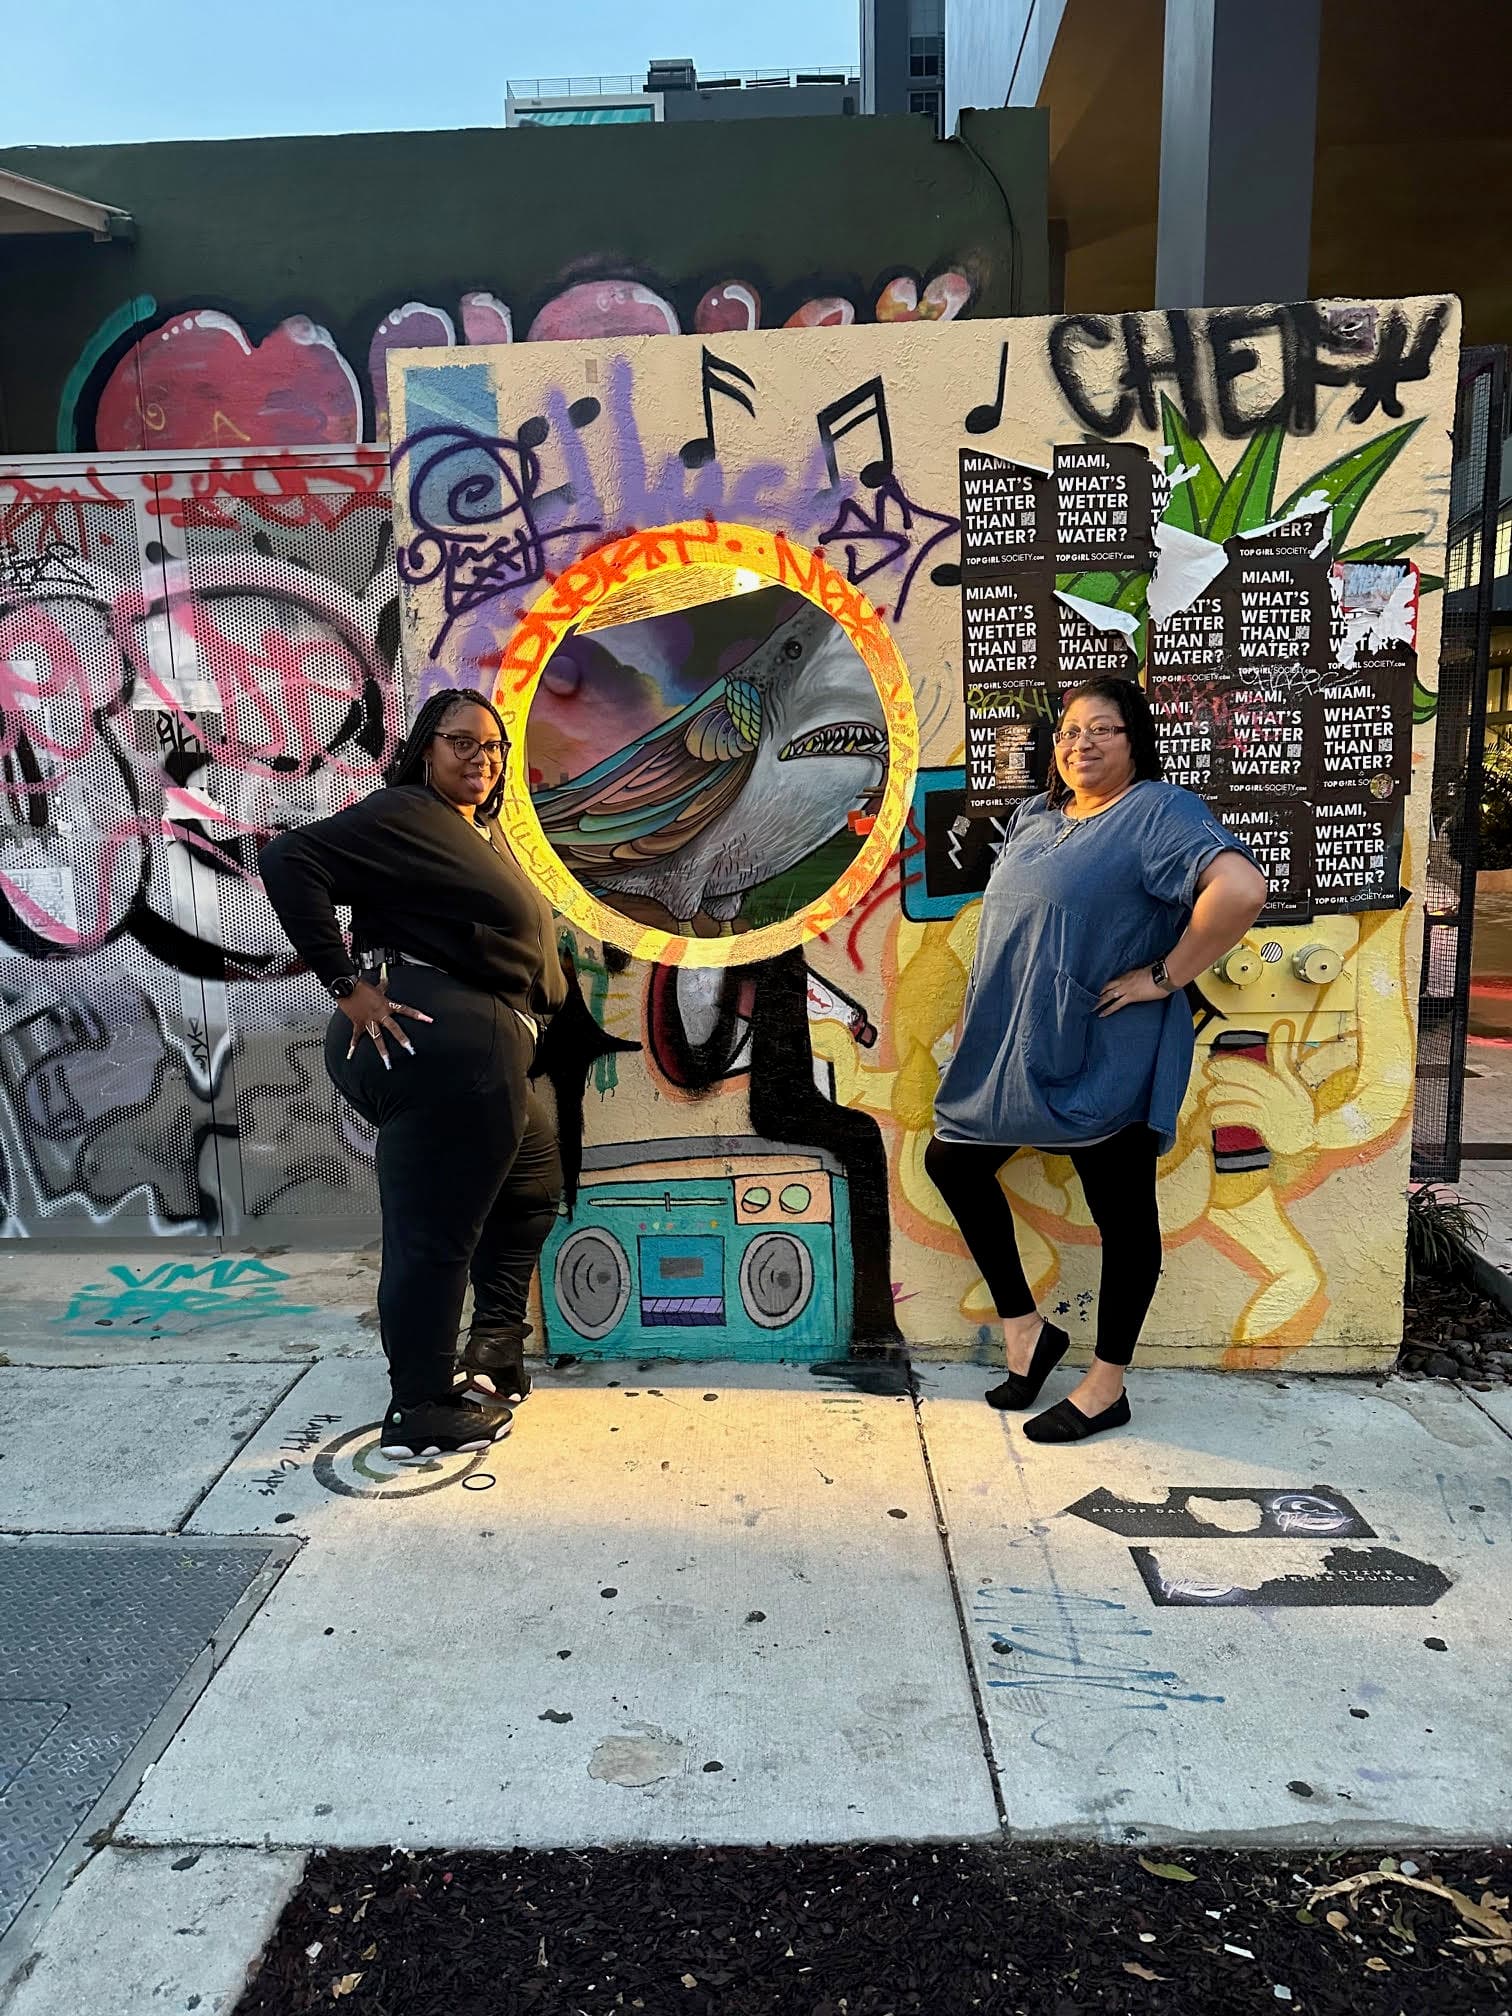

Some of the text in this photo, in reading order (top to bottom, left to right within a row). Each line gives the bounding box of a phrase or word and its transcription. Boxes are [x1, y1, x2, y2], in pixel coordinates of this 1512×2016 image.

[1057, 454, 1111, 469] MIAMI,
[964, 476, 1033, 495] WHAT'S
[1057, 475, 1126, 492] WHAT'S
[966, 494, 1036, 513] WETTER
[1058, 493, 1129, 509] WETTER
[966, 512, 1015, 530] THAN
[1057, 511, 1107, 526] THAN
[966, 529, 1037, 547] WATER?
[1057, 527, 1128, 544] WATER?
[1055, 554, 1071, 562] TOP
[1072, 553, 1090, 562] GIRL
[1255, 548, 1274, 556] GIRL
[966, 557, 982, 565] TOP
[982, 555, 1000, 564] GIRL
[1242, 570, 1294, 585] MIAMI,
[967, 585, 1018, 600] MIAMI,
[1241, 591, 1310, 607] WHAT'S
[967, 605, 1034, 623] WHAT'S
[1241, 608, 1311, 624] WETTER
[968, 623, 1037, 640] WETTER
[1155, 616, 1224, 632] WETTER
[1153, 633, 1203, 649] THAN
[1240, 626, 1289, 641] THAN
[968, 640, 1016, 656] THAN
[1059, 639, 1107, 653] THAN
[1240, 642, 1310, 657] WATER?
[968, 655, 1038, 673] WATER?
[1059, 654, 1128, 671] WATER?
[1153, 650, 1224, 665] WATER?
[1152, 675, 1167, 683] TOP
[1167, 674, 1186, 682] GIRL
[1238, 667, 1253, 675] TOP
[983, 682, 1001, 690] GIRL
[1057, 680, 1072, 688] TOP
[1235, 690, 1287, 704] MIAMI,
[1324, 685, 1376, 700] MIAMI,
[969, 706, 1020, 720] MIAMI,
[1234, 710, 1302, 725] WHAT'S
[1324, 705, 1392, 722] WHAT'S
[1155, 721, 1209, 737] HAT'S
[1234, 727, 1303, 742] WETTER
[1324, 722, 1393, 739] WETTER
[1155, 738, 1212, 754] ETTER
[1233, 744, 1282, 758] THAN
[1324, 739, 1373, 755] THAN
[1231, 760, 1301, 775] WATER?
[1324, 754, 1393, 772] WATER?
[1229, 784, 1243, 792] TOP
[1323, 780, 1338, 788] TOP
[1338, 779, 1357, 787] GIRL
[986, 798, 1003, 806] GIRL
[1316, 803, 1367, 818] MIAMI,
[1222, 811, 1274, 826] MIAMI,
[1236, 831, 1289, 846] HAT'S
[1315, 822, 1382, 840] WHAT'S
[1252, 847, 1291, 862] TTER
[1315, 839, 1385, 856] WETTER
[1315, 856, 1364, 872] THAN
[1315, 871, 1385, 888] WATER?
[1315, 897, 1330, 905] TOP
[1330, 896, 1348, 904] GIRL
